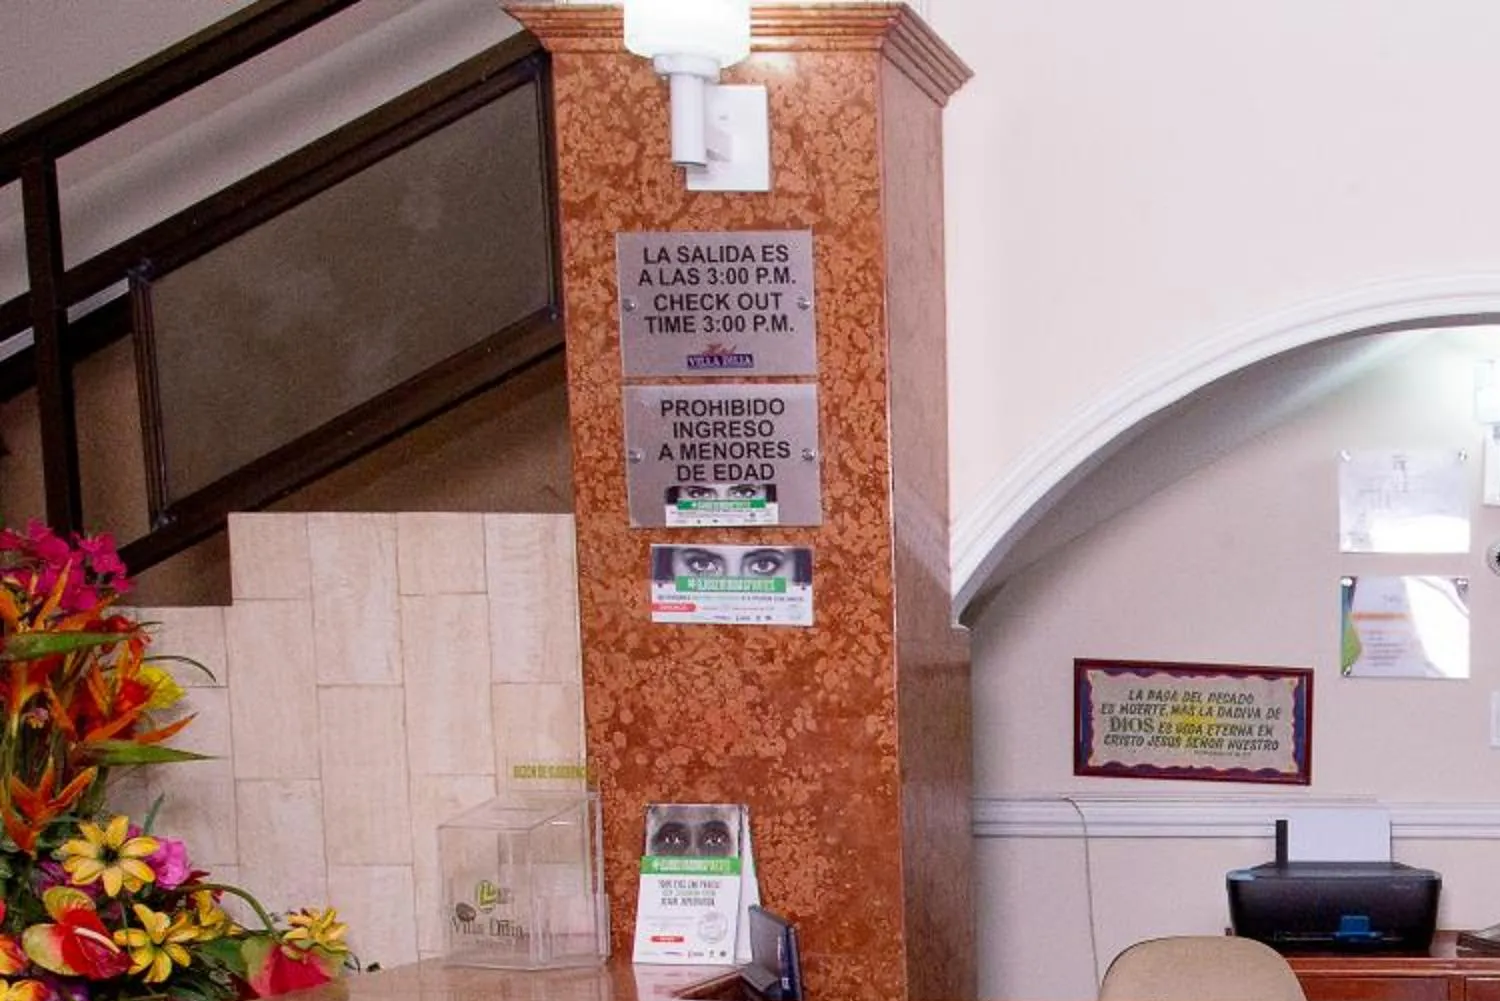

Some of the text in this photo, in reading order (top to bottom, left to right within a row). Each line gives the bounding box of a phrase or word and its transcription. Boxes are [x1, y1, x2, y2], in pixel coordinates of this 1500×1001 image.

[643, 245, 789, 264] LA SALIDA ES
[638, 267, 796, 286] A LAS 3:00 P.M.
[653, 293, 783, 312] CHECK OUT
[645, 315, 794, 334] TIME 3:00 P.M.
[661, 398, 785, 416] PROHIBIDO
[673, 421, 774, 439] INGRESO
[658, 441, 791, 461] A MENORES
[677, 464, 775, 481] DE EDAD
[1128, 689, 1144, 701] LA
[1182, 691, 1202, 703] DEL
[1207, 692, 1255, 705] PECADO
[1199, 706, 1213, 717] LA
[1265, 707, 1281, 720] DE
[1110, 716, 1155, 733] DIOS
[1207, 723, 1253, 737] ETERNA
[1103, 734, 1145, 747] CRISTO
[1227, 738, 1279, 751] NUESTRO
